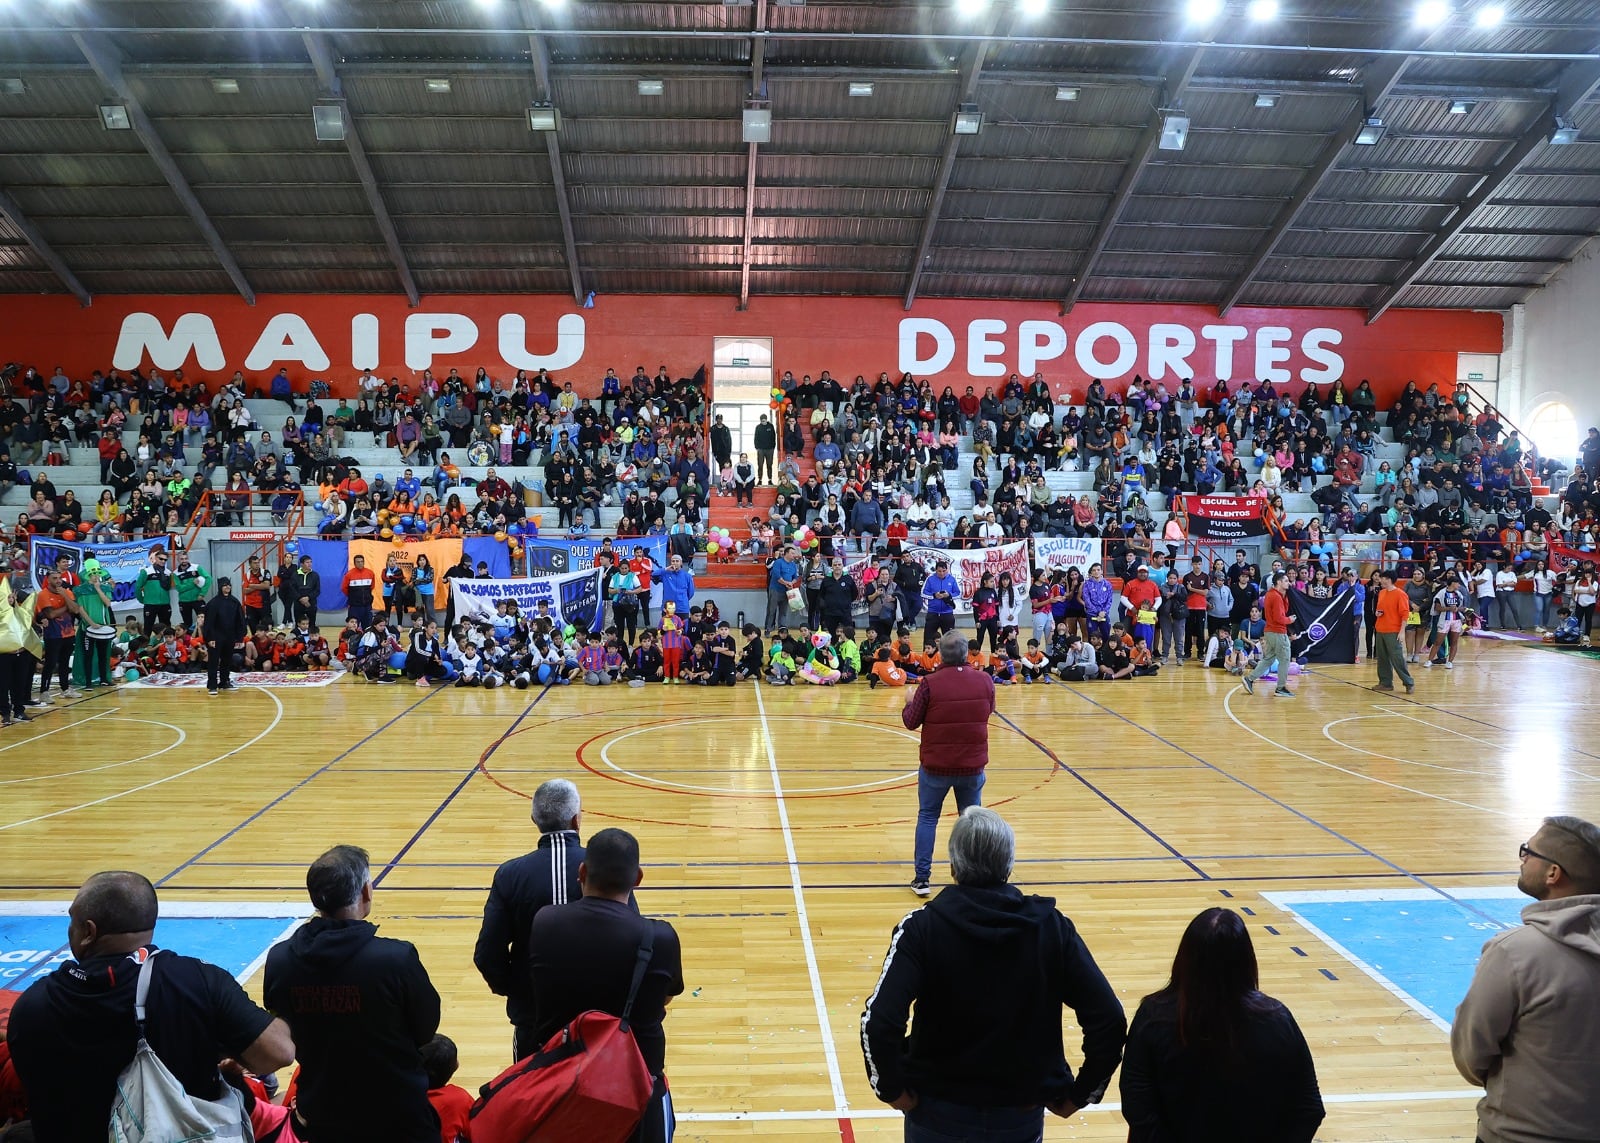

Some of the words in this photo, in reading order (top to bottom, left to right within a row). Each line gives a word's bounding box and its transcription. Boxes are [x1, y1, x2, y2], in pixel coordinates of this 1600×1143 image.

[112, 313, 587, 374] MAIPU
[898, 318, 1345, 384] DEPORTES
[1210, 520, 1243, 528] FUTBOL
[1207, 529, 1248, 537] MENDOZA
[571, 545, 590, 557] QUE
[1037, 539, 1093, 558] ESCUELITA
[471, 584, 501, 597] SOMOS
[502, 581, 552, 596] PERFECTOS
